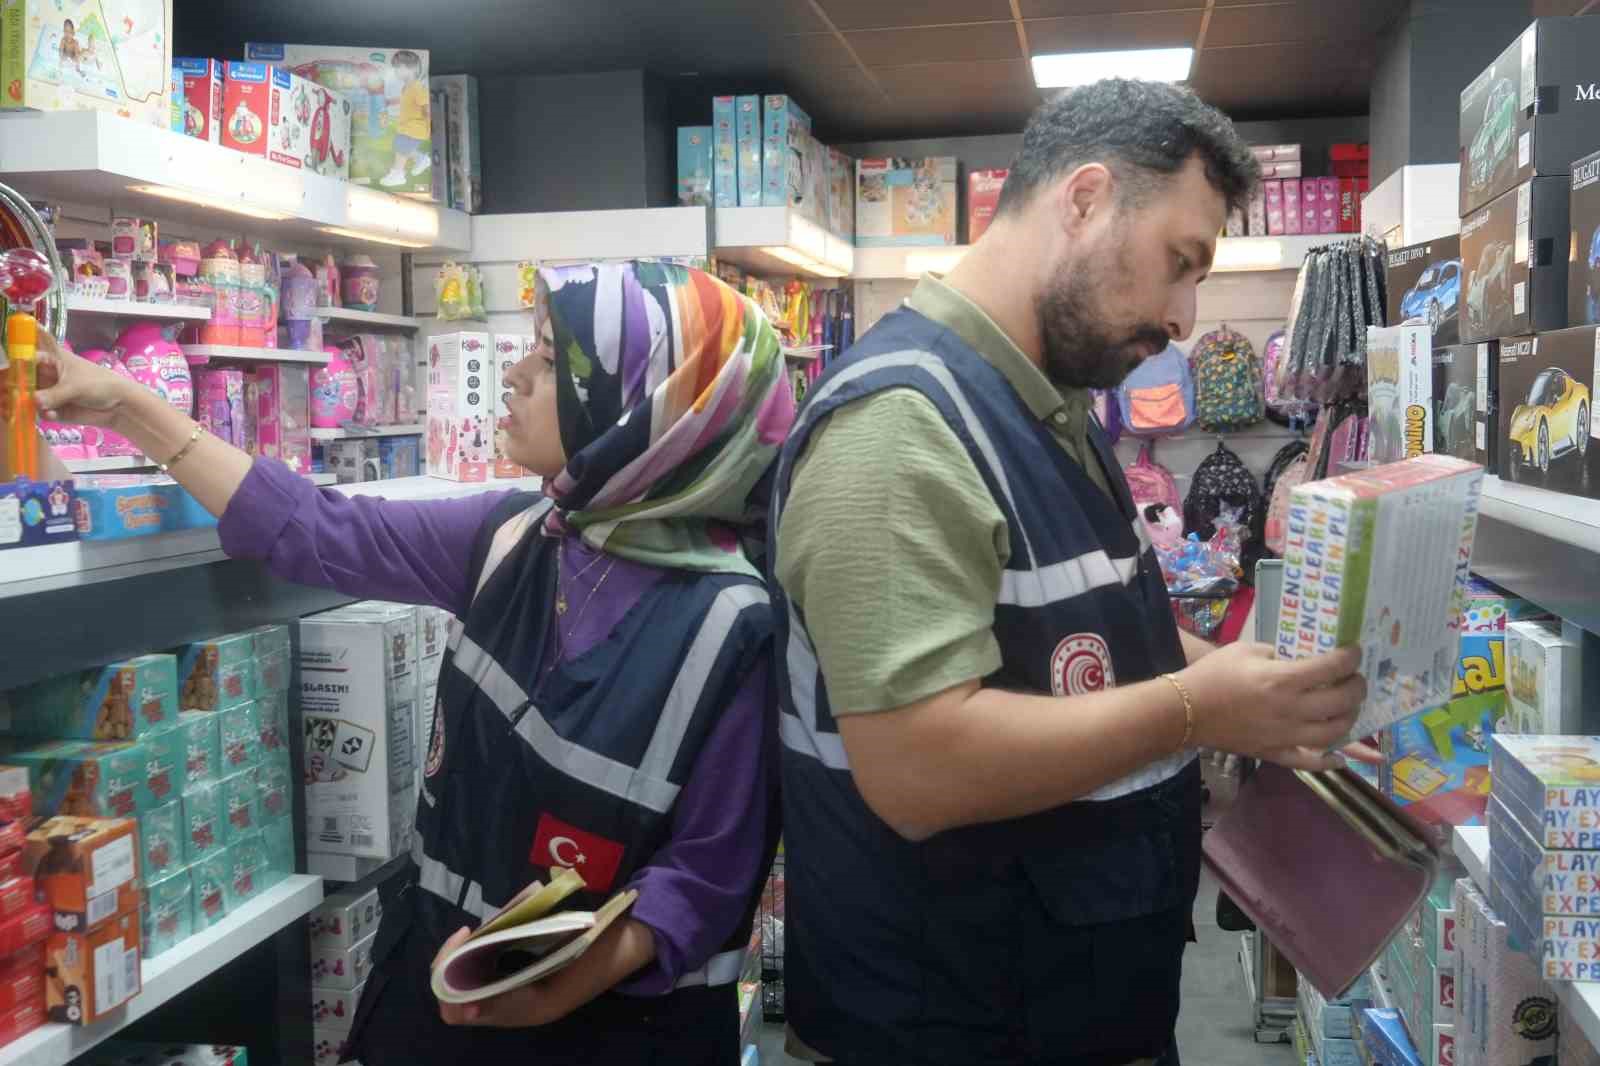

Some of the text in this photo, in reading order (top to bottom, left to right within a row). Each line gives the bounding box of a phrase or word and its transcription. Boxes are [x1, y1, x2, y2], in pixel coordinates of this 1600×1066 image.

[1306, 511, 1328, 582] LEARN
[1320, 543, 1346, 617] LEARN
[1297, 586, 1320, 656] IENCE
[1547, 788, 1600, 808] PLAY
[1545, 853, 1599, 872] PLAY
[1545, 895, 1600, 912] EXPE
[1545, 919, 1600, 938] PLAY
[1547, 960, 1600, 979] EXPE
